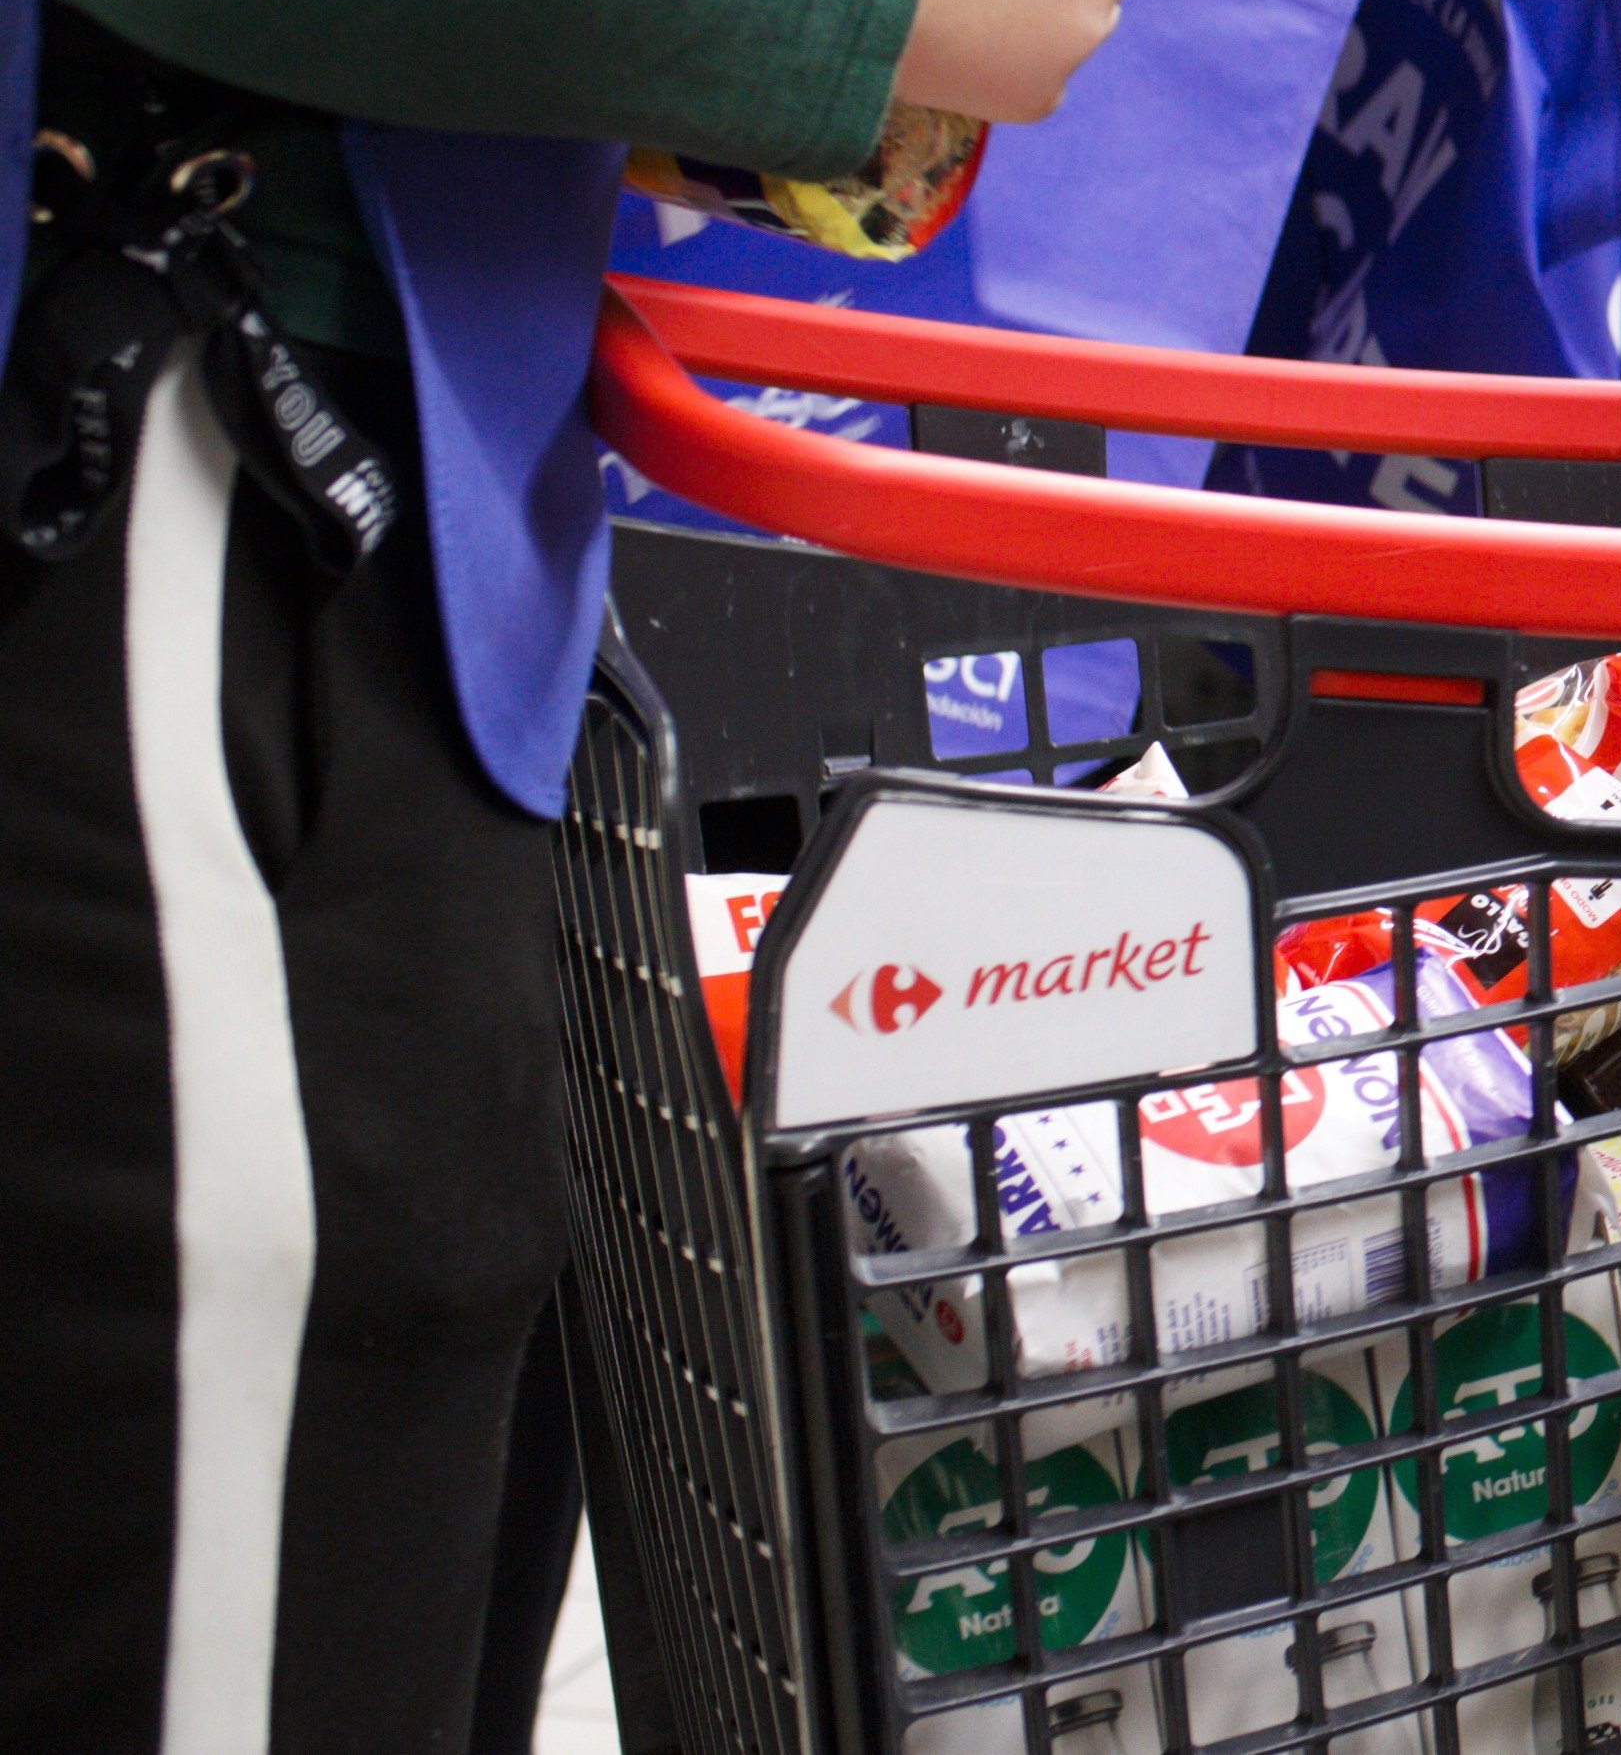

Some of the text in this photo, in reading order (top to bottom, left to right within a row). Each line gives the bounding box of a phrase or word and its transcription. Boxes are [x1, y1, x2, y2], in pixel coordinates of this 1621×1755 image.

[262, 345, 346, 468] YOU
[964, 921, 1212, 1010] market
[1472, 1465, 1549, 1504] Natur
[958, 1593, 1061, 1640] Nata
